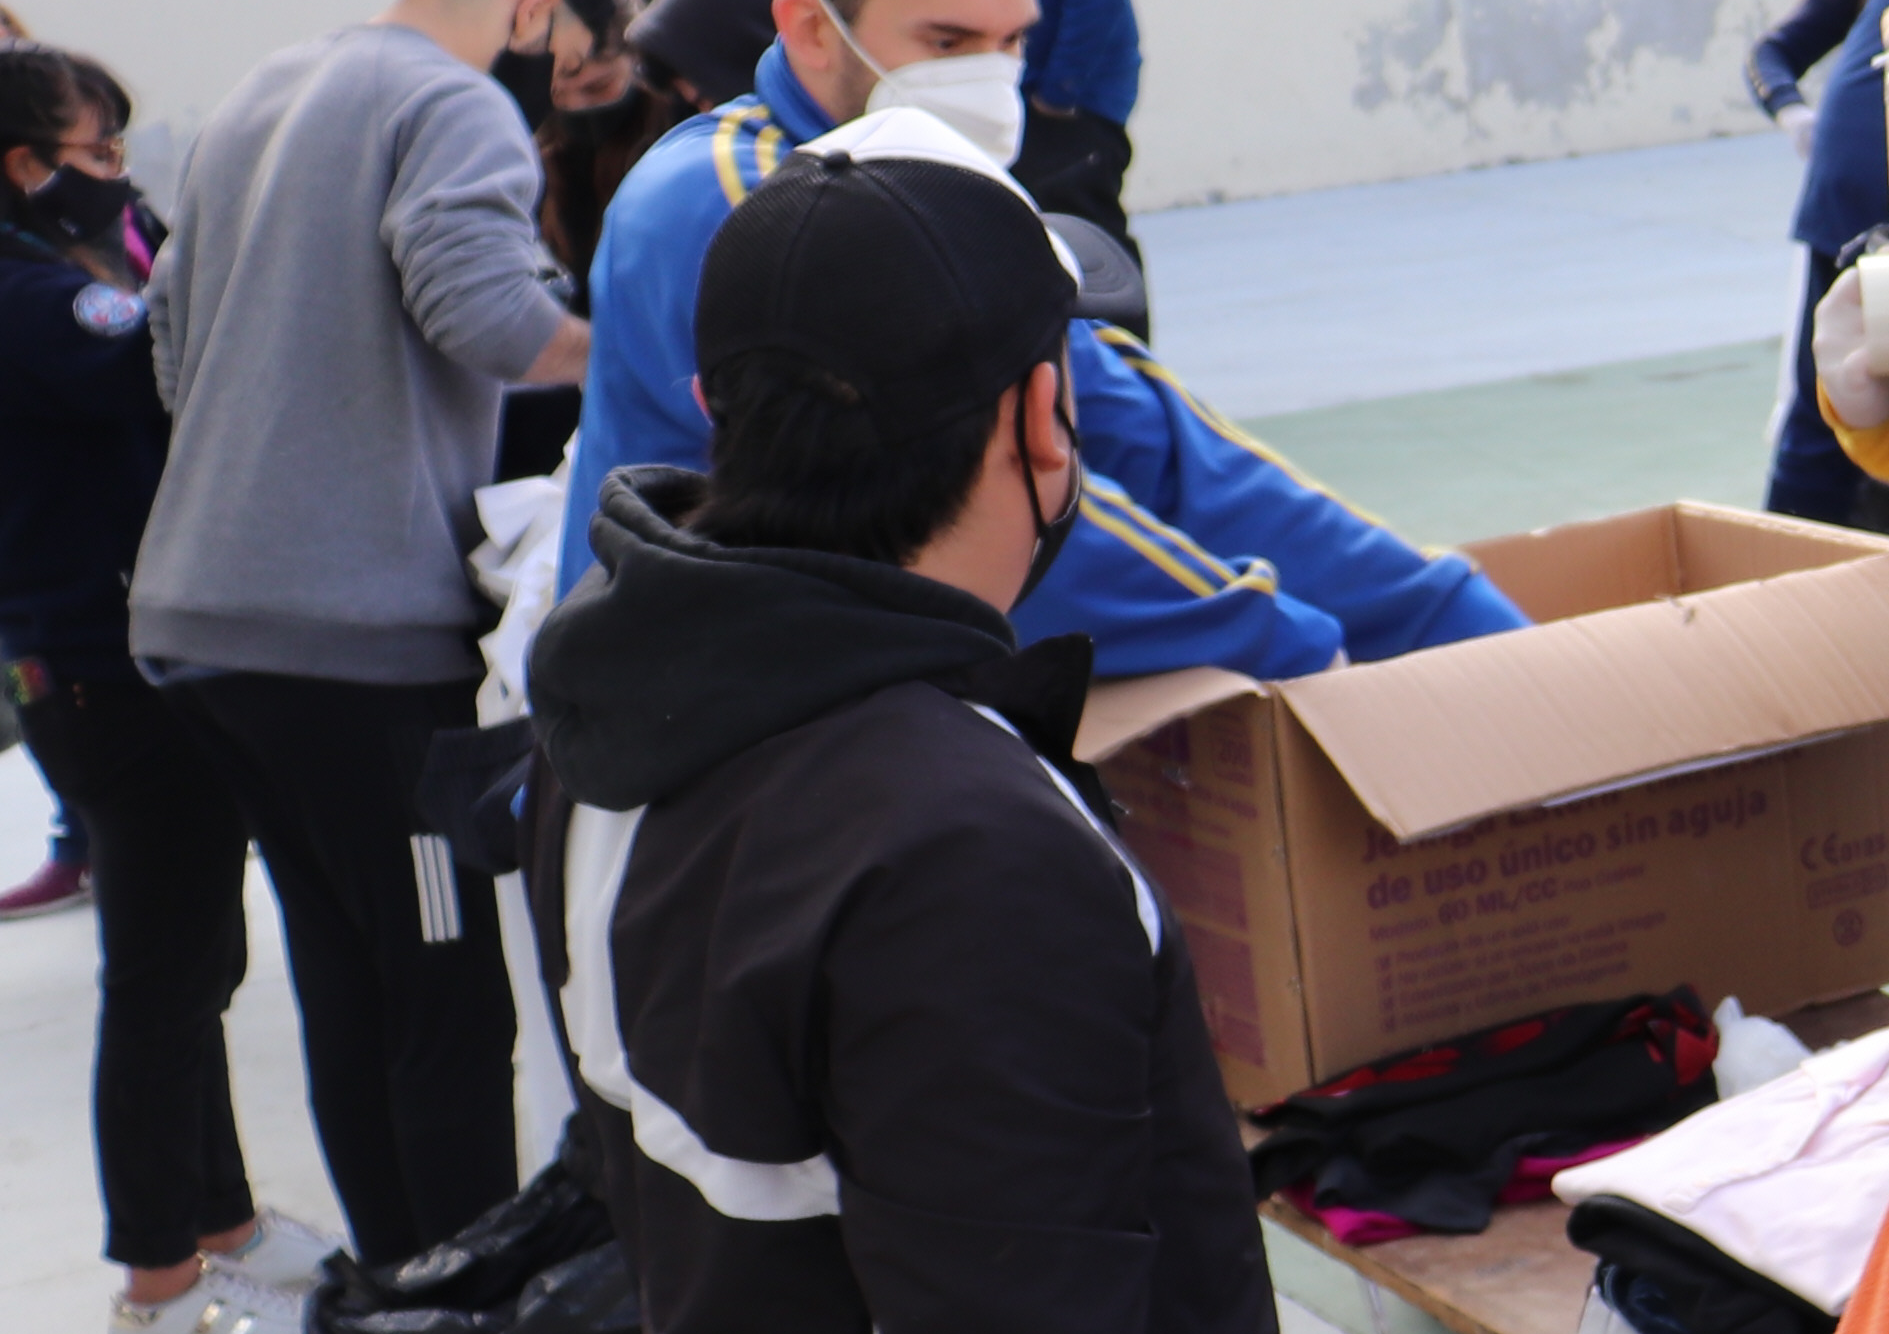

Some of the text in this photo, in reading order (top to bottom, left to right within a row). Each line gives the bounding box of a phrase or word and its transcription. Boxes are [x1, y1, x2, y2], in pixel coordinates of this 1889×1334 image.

[1366, 872, 1413, 910] de
[1423, 857, 1489, 896] uso
[1499, 835, 1597, 878] único
[1605, 810, 1660, 852] sin
[1667, 787, 1768, 839] aguja
[1475, 877, 1558, 914] ML/CC
